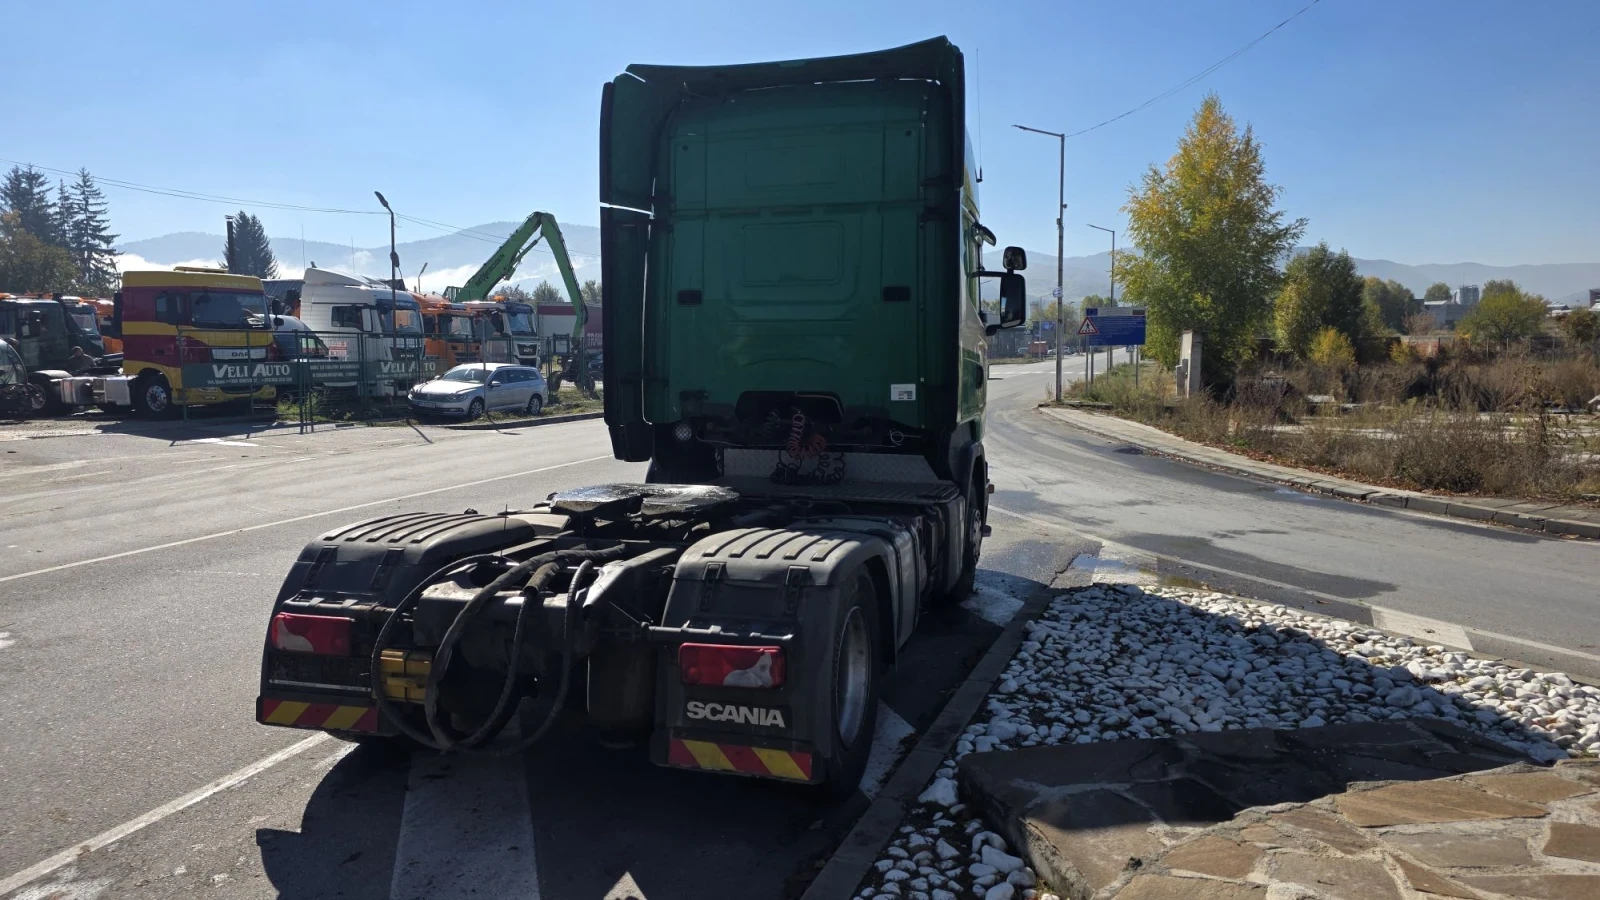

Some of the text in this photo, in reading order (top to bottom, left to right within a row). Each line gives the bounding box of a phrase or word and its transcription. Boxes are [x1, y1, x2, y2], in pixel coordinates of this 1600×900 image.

[212, 363, 290, 379] VELI AUTO
[380, 361, 436, 373] VELI ATO
[686, 701, 786, 728] SCANIA
